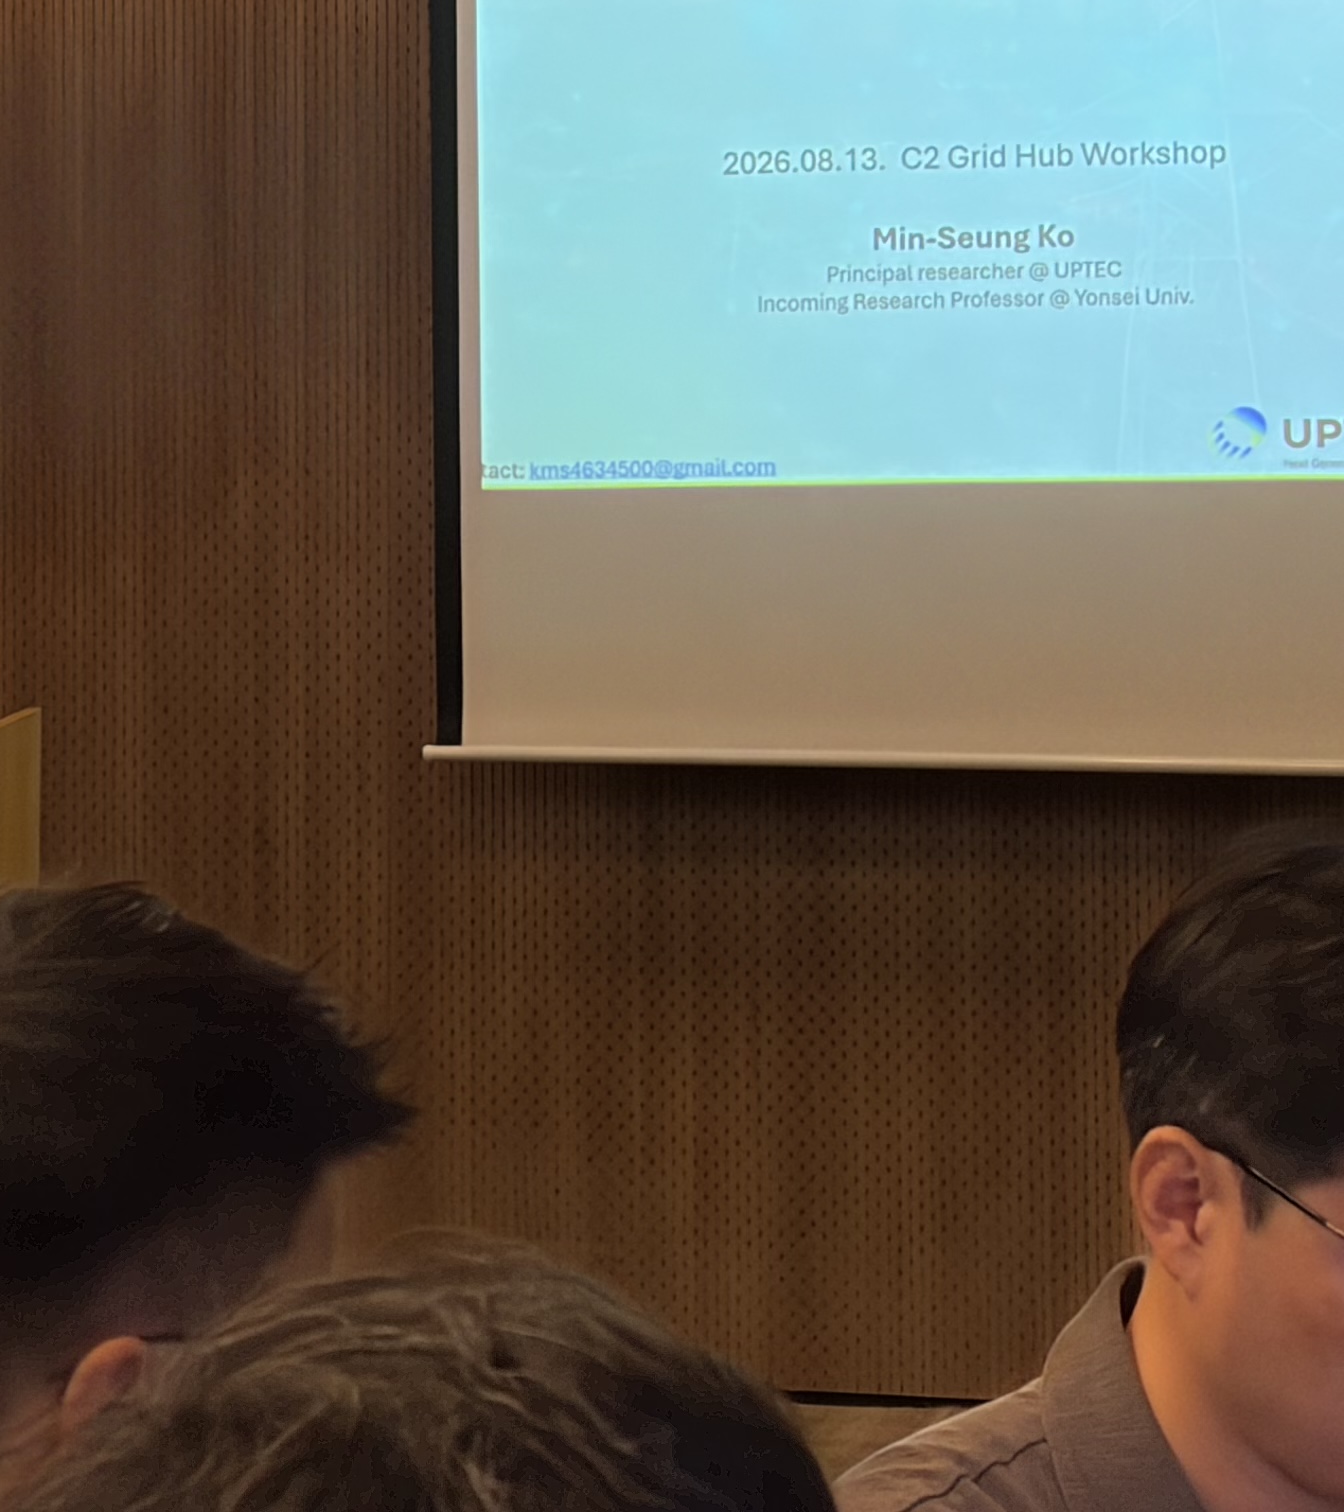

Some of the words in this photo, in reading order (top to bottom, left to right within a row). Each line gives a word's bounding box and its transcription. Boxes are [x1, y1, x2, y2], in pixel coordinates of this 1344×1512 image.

[723, 146, 887, 176] 2026.08.13.
[901, 145, 941, 170] C2
[948, 143, 1007, 170] Grid
[1015, 141, 1074, 168] Hub
[1080, 140, 1227, 170] Workshop
[872, 225, 1031, 254] Min-Seung
[1037, 224, 1075, 249] Ko
[827, 263, 913, 287] Principal
[917, 261, 1024, 283] researcher
[1028, 262, 1050, 284] @
[1054, 260, 1122, 280] UPTEC
[757, 293, 849, 316] Incoming
[853, 291, 945, 312] Research
[950, 289, 1044, 310] Professor
[1048, 289, 1071, 309] @
[1075, 287, 1140, 308] Yonsei
[1146, 286, 1195, 307] Univ.
[529, 458, 777, 482] kms4634500@gmail.com
